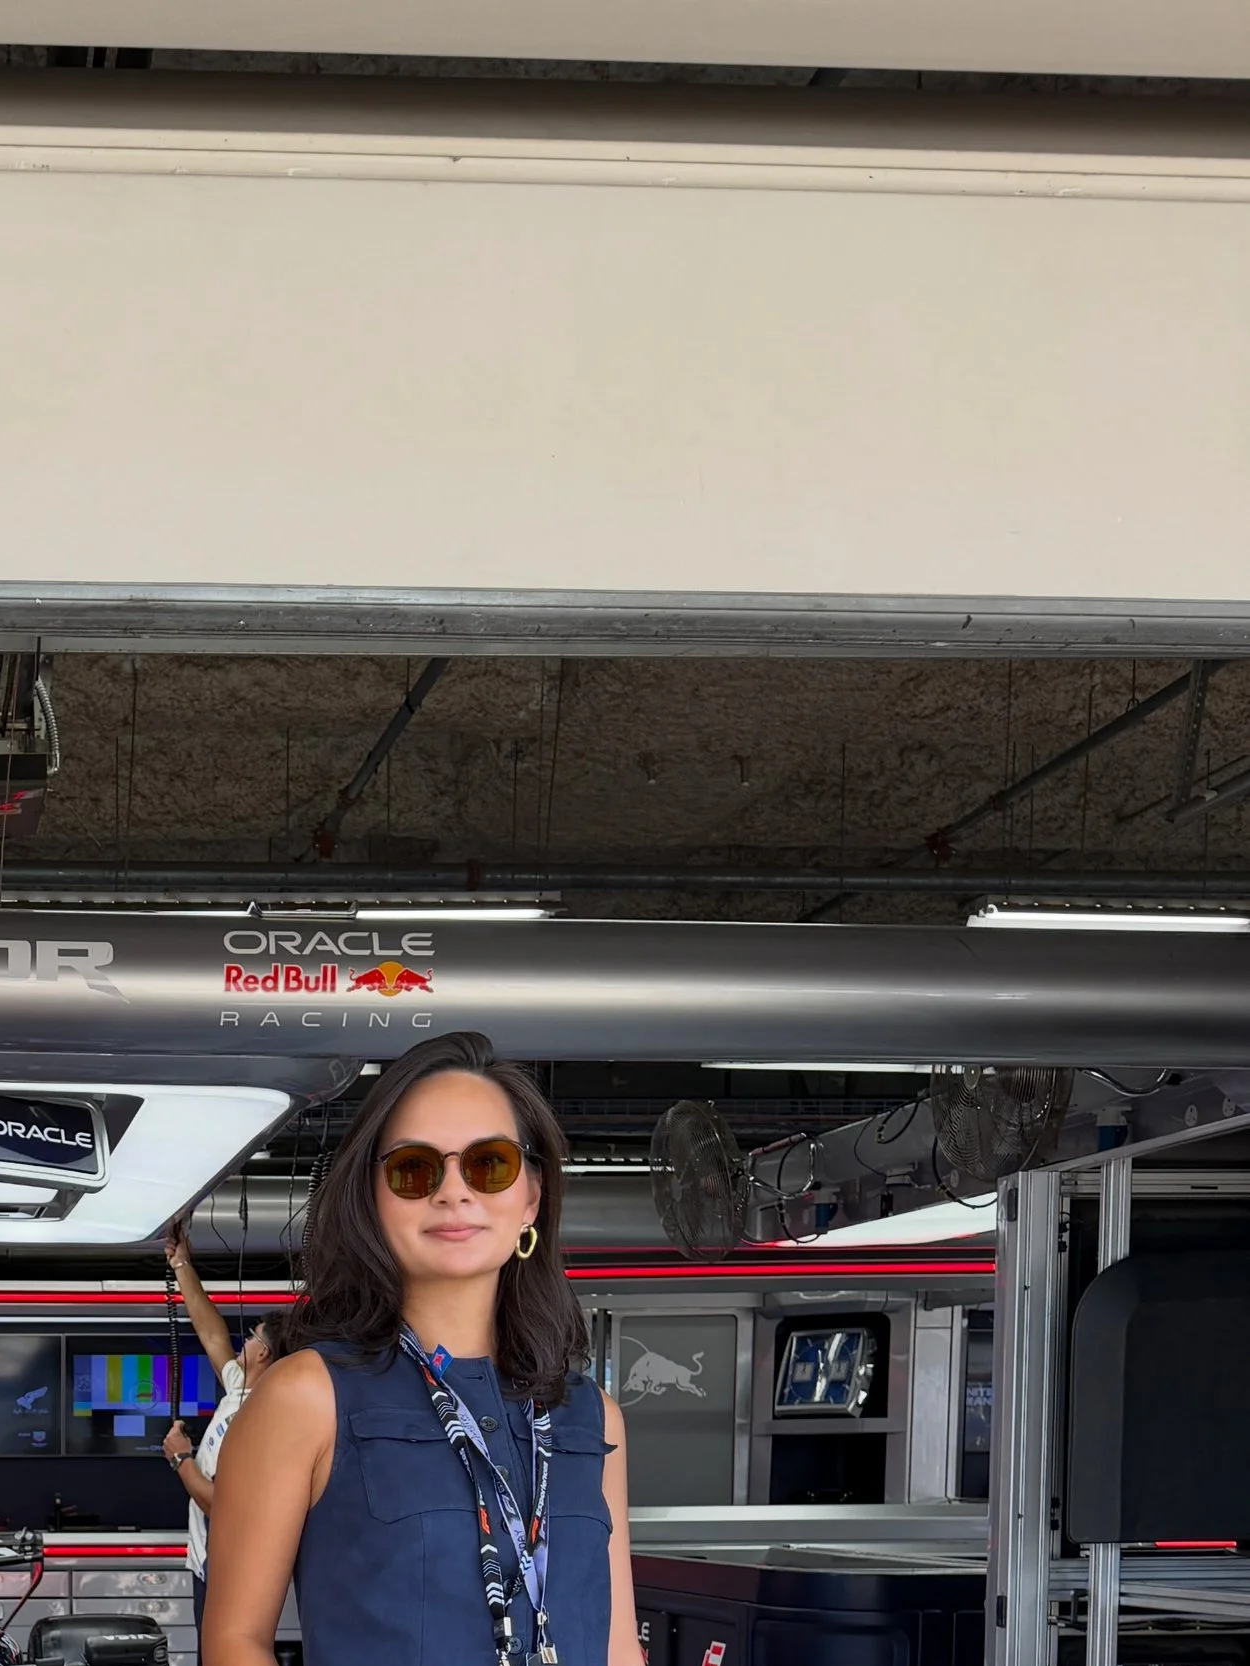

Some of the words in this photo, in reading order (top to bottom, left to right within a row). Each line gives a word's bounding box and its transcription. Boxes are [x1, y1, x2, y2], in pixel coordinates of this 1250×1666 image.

[223, 929, 436, 958] ORACLE
[224, 964, 281, 995] Red
[285, 962, 337, 994] Bull
[219, 1011, 433, 1030] RACING
